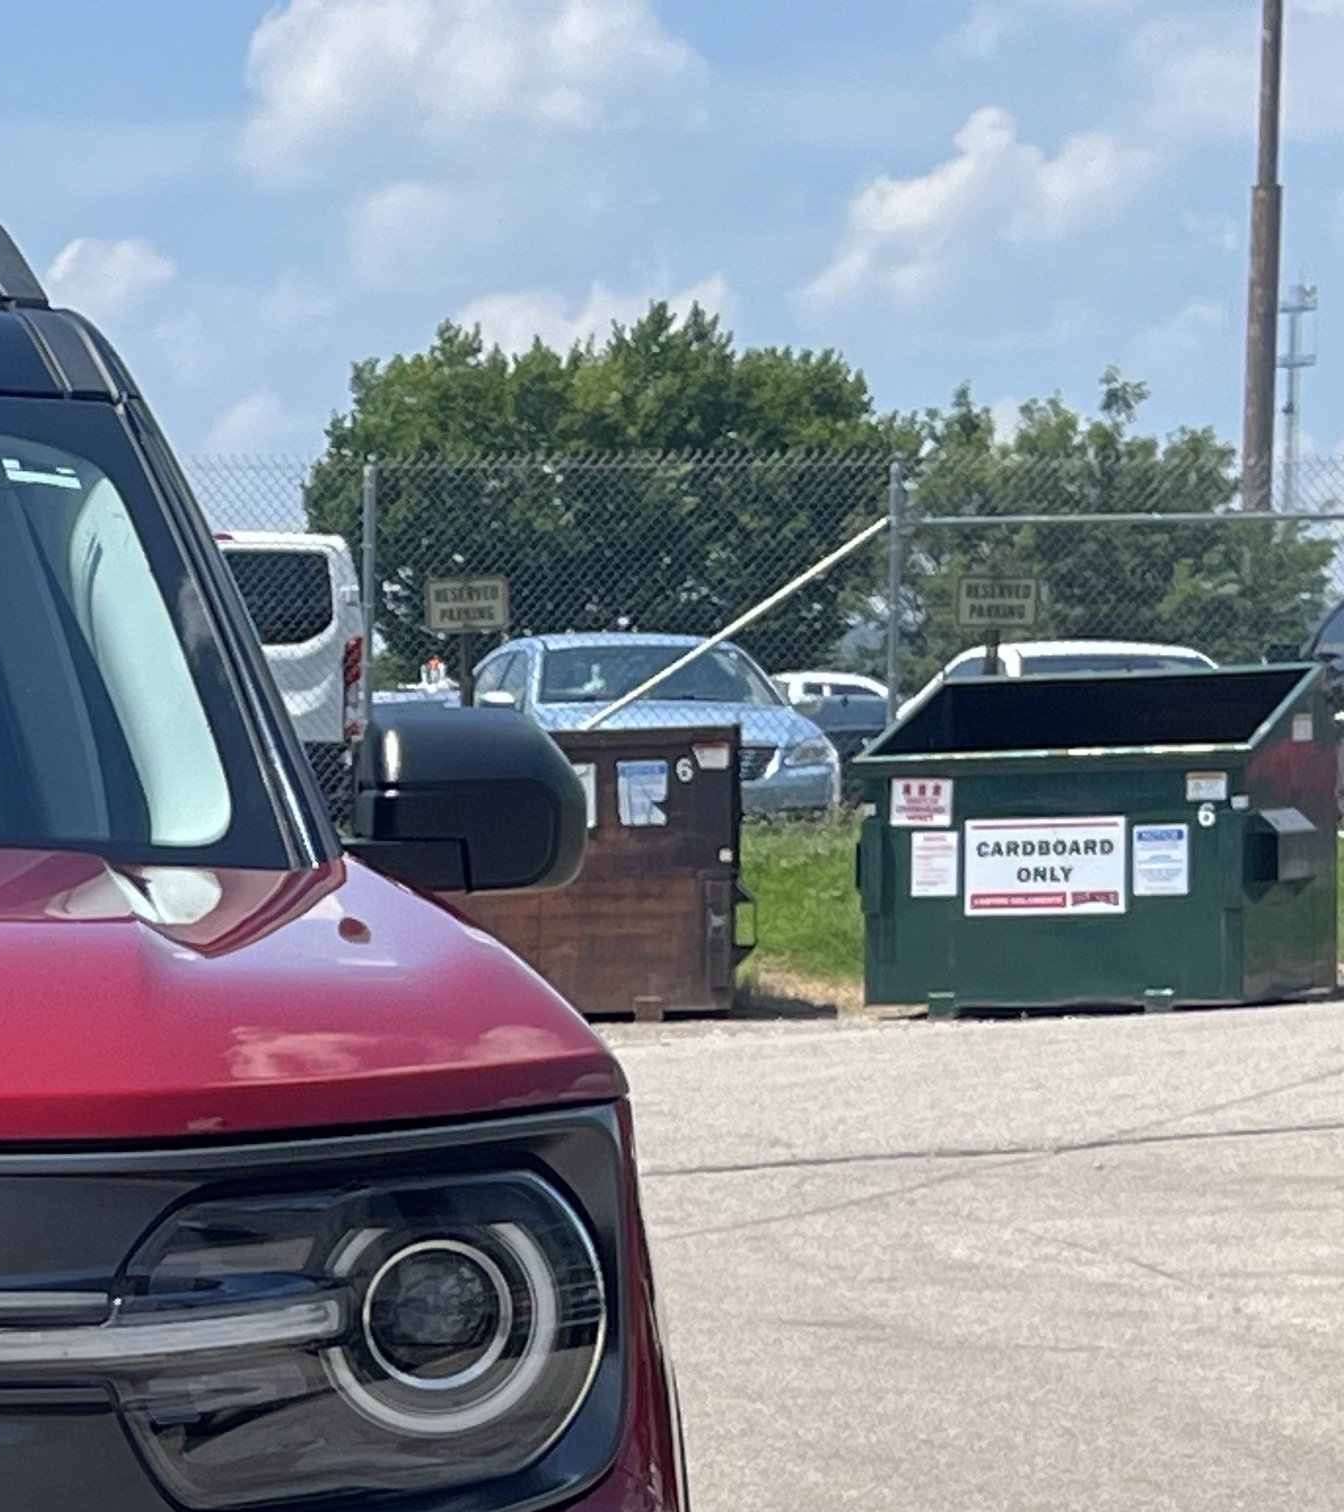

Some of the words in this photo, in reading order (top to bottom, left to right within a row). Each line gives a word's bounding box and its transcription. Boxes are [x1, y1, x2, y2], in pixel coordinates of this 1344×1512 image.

[675, 758, 694, 783] 6
[1197, 802, 1216, 828] 6
[976, 838, 1115, 858] CARDBOARD
[1016, 865, 1074, 883] ONLY
